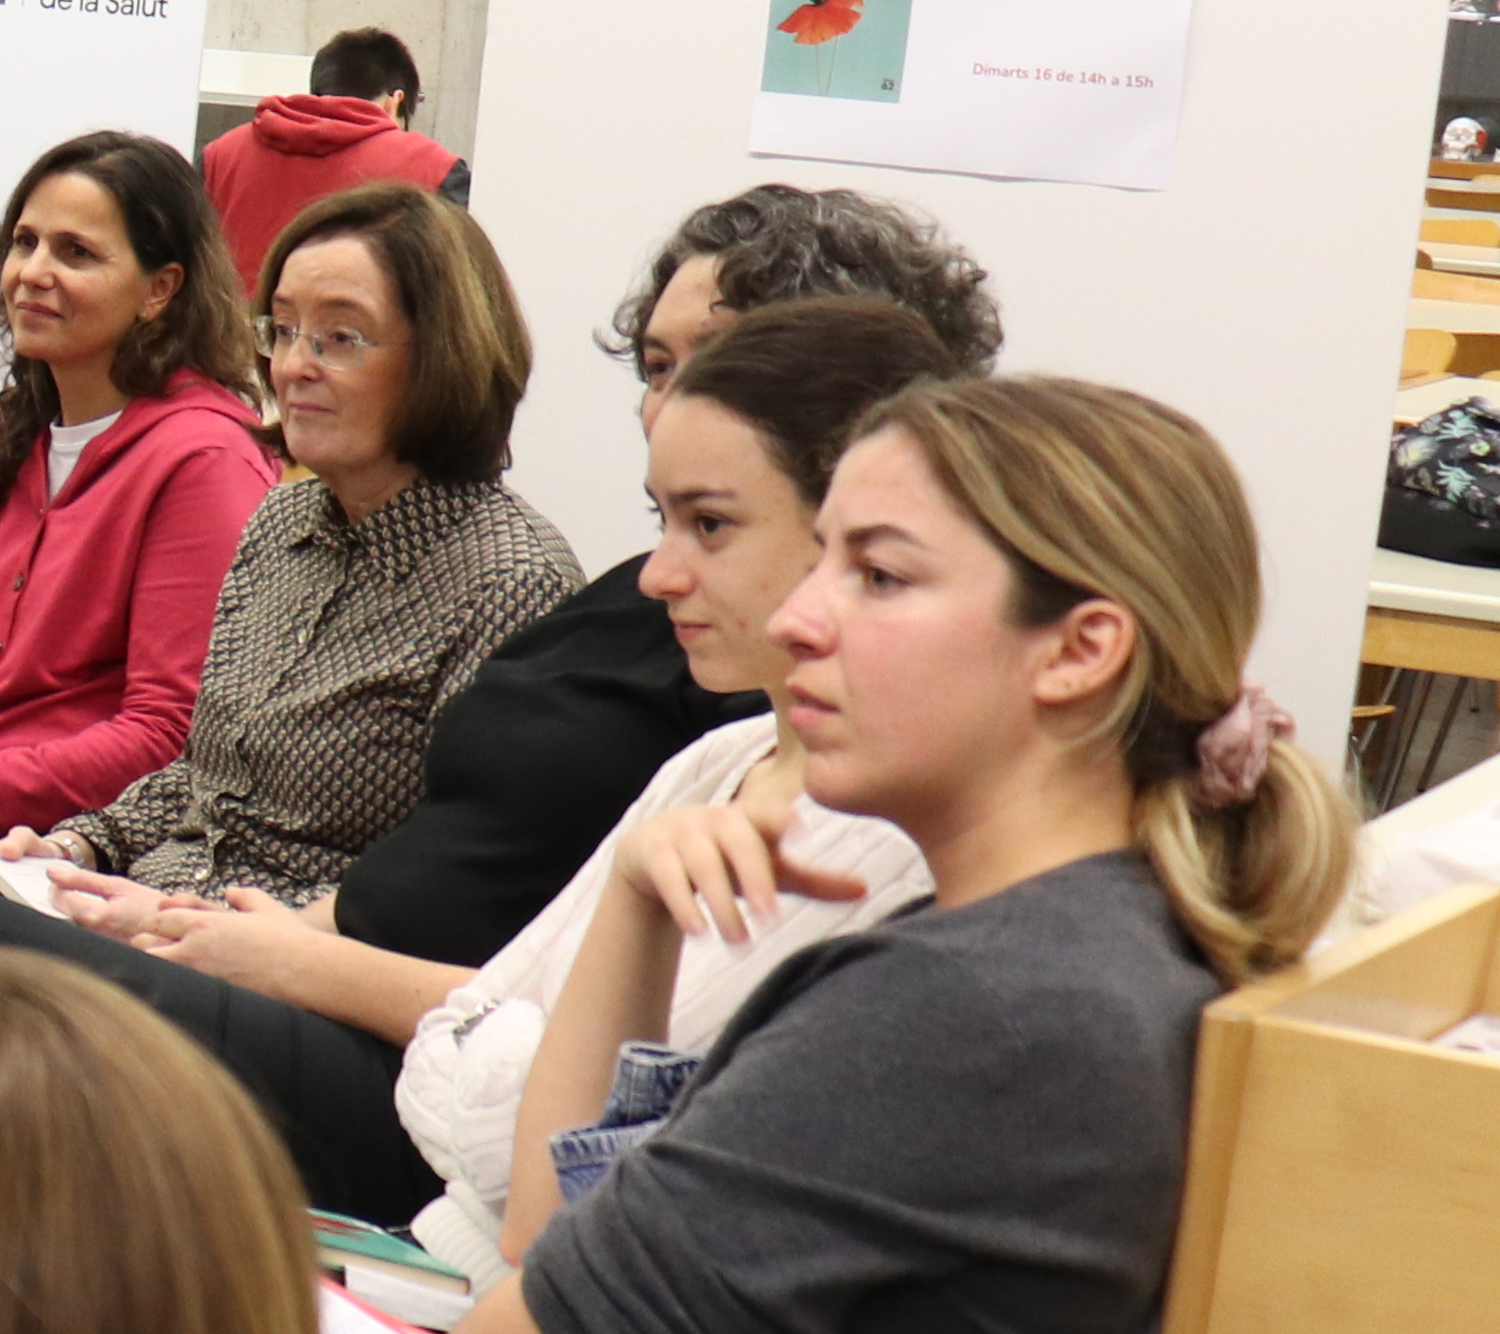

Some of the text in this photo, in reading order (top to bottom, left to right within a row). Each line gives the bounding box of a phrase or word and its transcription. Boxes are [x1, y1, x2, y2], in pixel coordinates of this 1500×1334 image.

[972, 63, 1154, 88] Dimarts 16 de 14h a 15h
